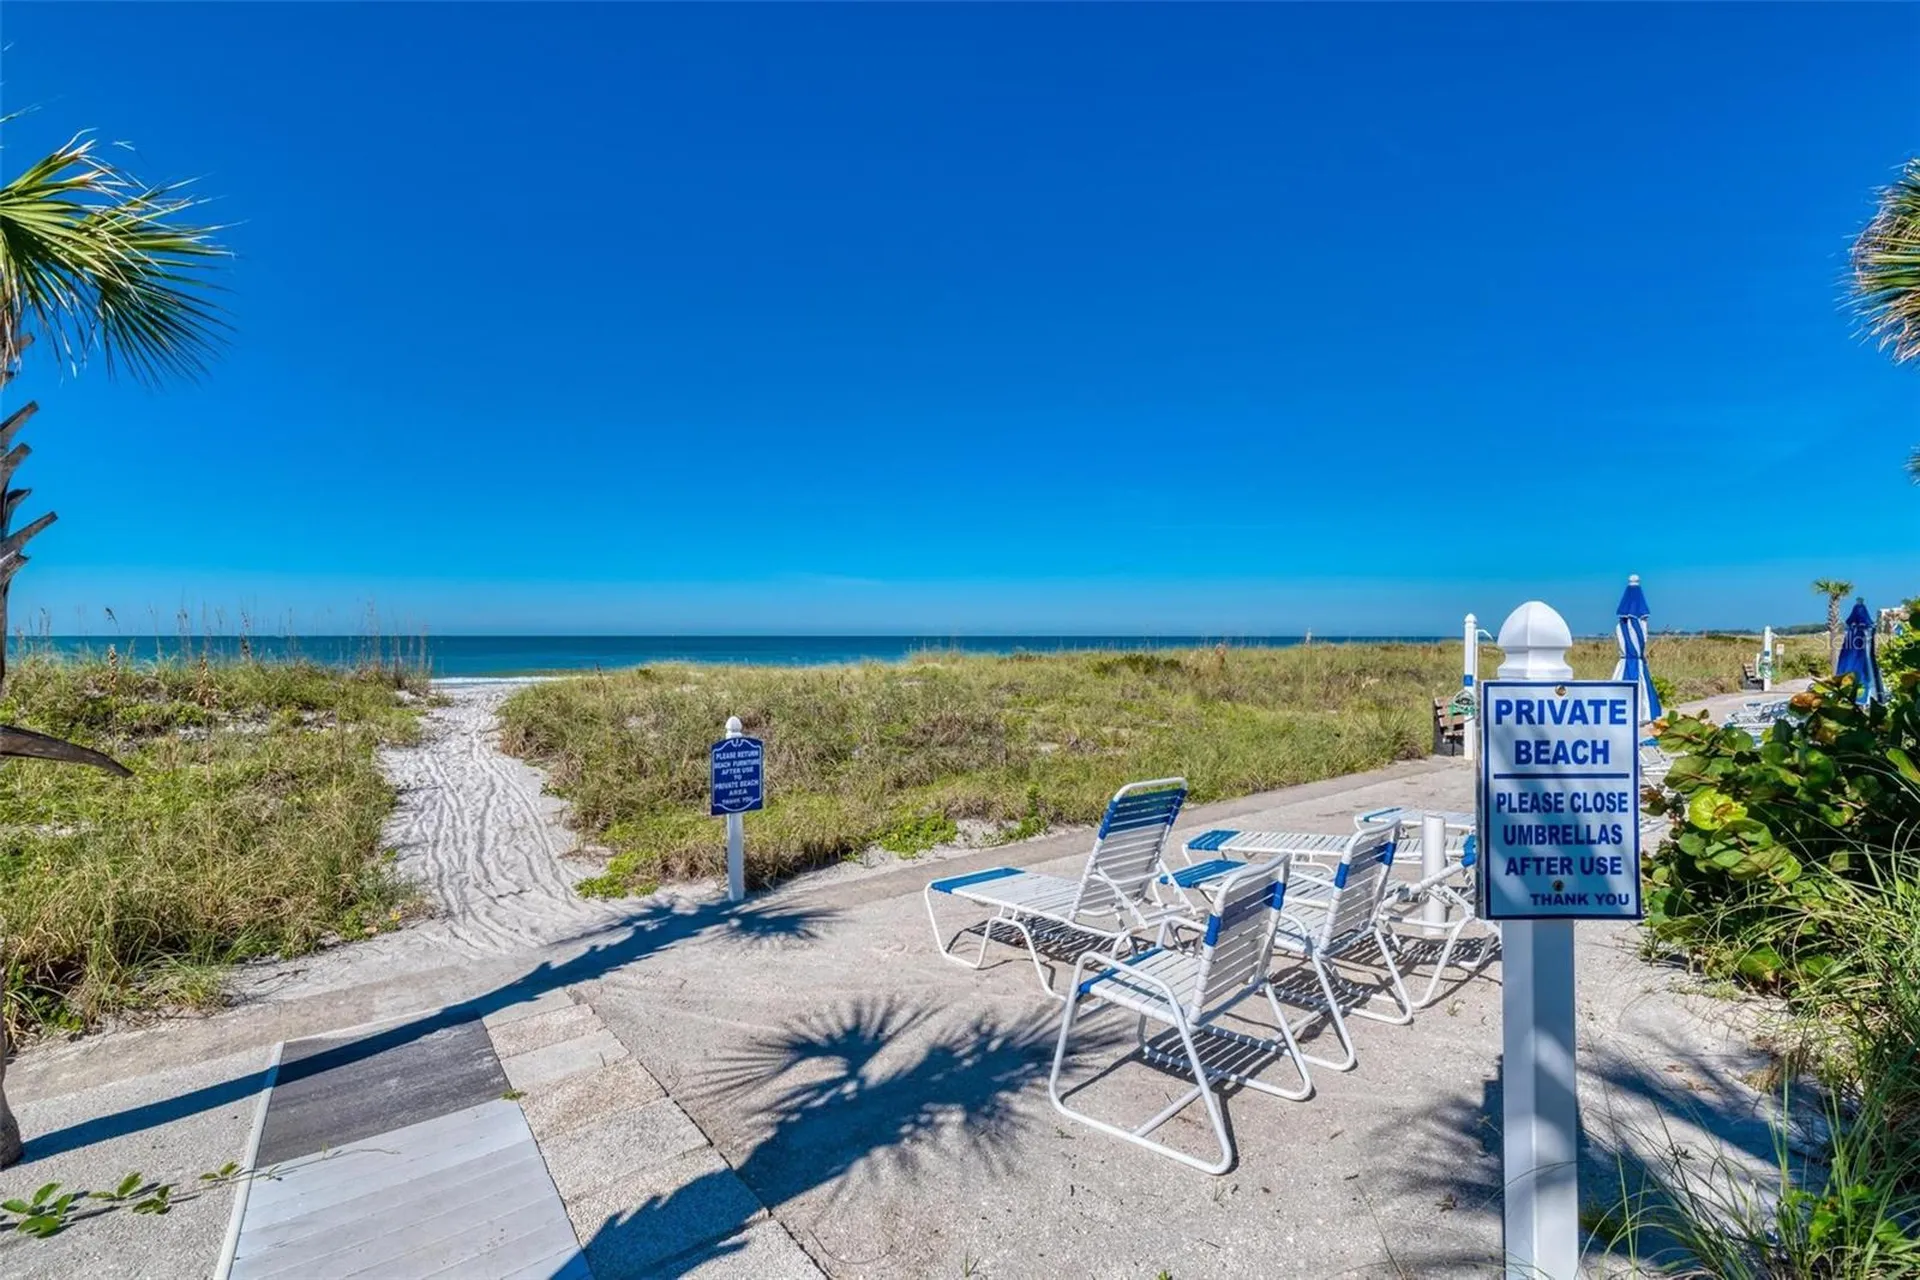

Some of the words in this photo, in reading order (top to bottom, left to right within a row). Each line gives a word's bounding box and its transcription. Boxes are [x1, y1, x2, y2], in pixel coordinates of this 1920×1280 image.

[1495, 699, 1628, 725] PRIVATE
[1514, 740, 1610, 765] BEACH
[714, 782, 738, 790] PRIVATE
[1496, 792, 1564, 813] PLEASE
[1570, 792, 1628, 813] CLOSE
[1503, 824, 1623, 846] UMBRELLAS
[1505, 857, 1574, 876] AFTER
[1580, 857, 1623, 876] USE
[1530, 893, 1589, 906] THANK
[1594, 893, 1629, 906] YOU
